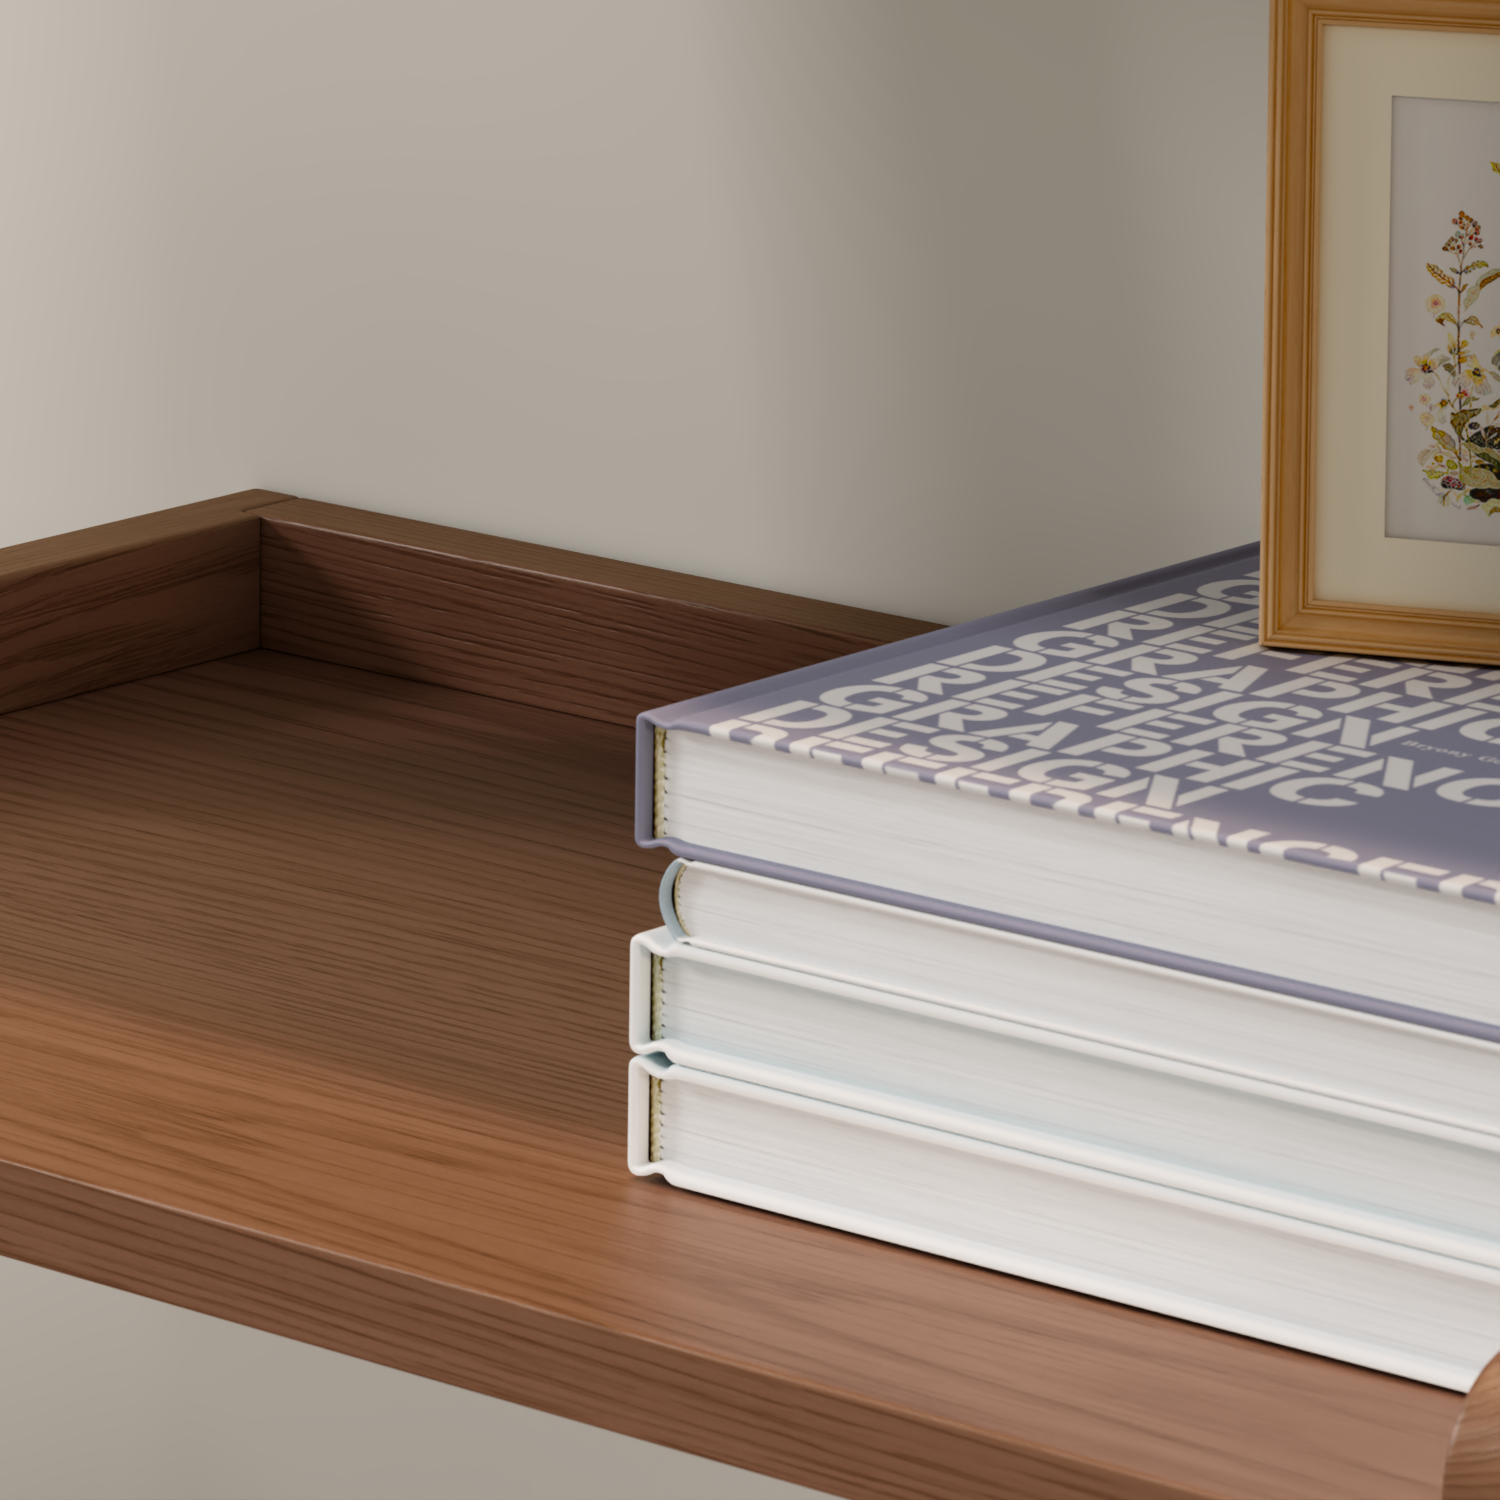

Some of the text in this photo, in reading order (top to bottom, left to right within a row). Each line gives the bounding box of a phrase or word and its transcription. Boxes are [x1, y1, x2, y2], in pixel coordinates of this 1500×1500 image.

[819, 685, 1384, 807] GRAPHIC
[936, 645, 1420, 748] DESIGN
[738, 700, 1229, 809] DESIGN
